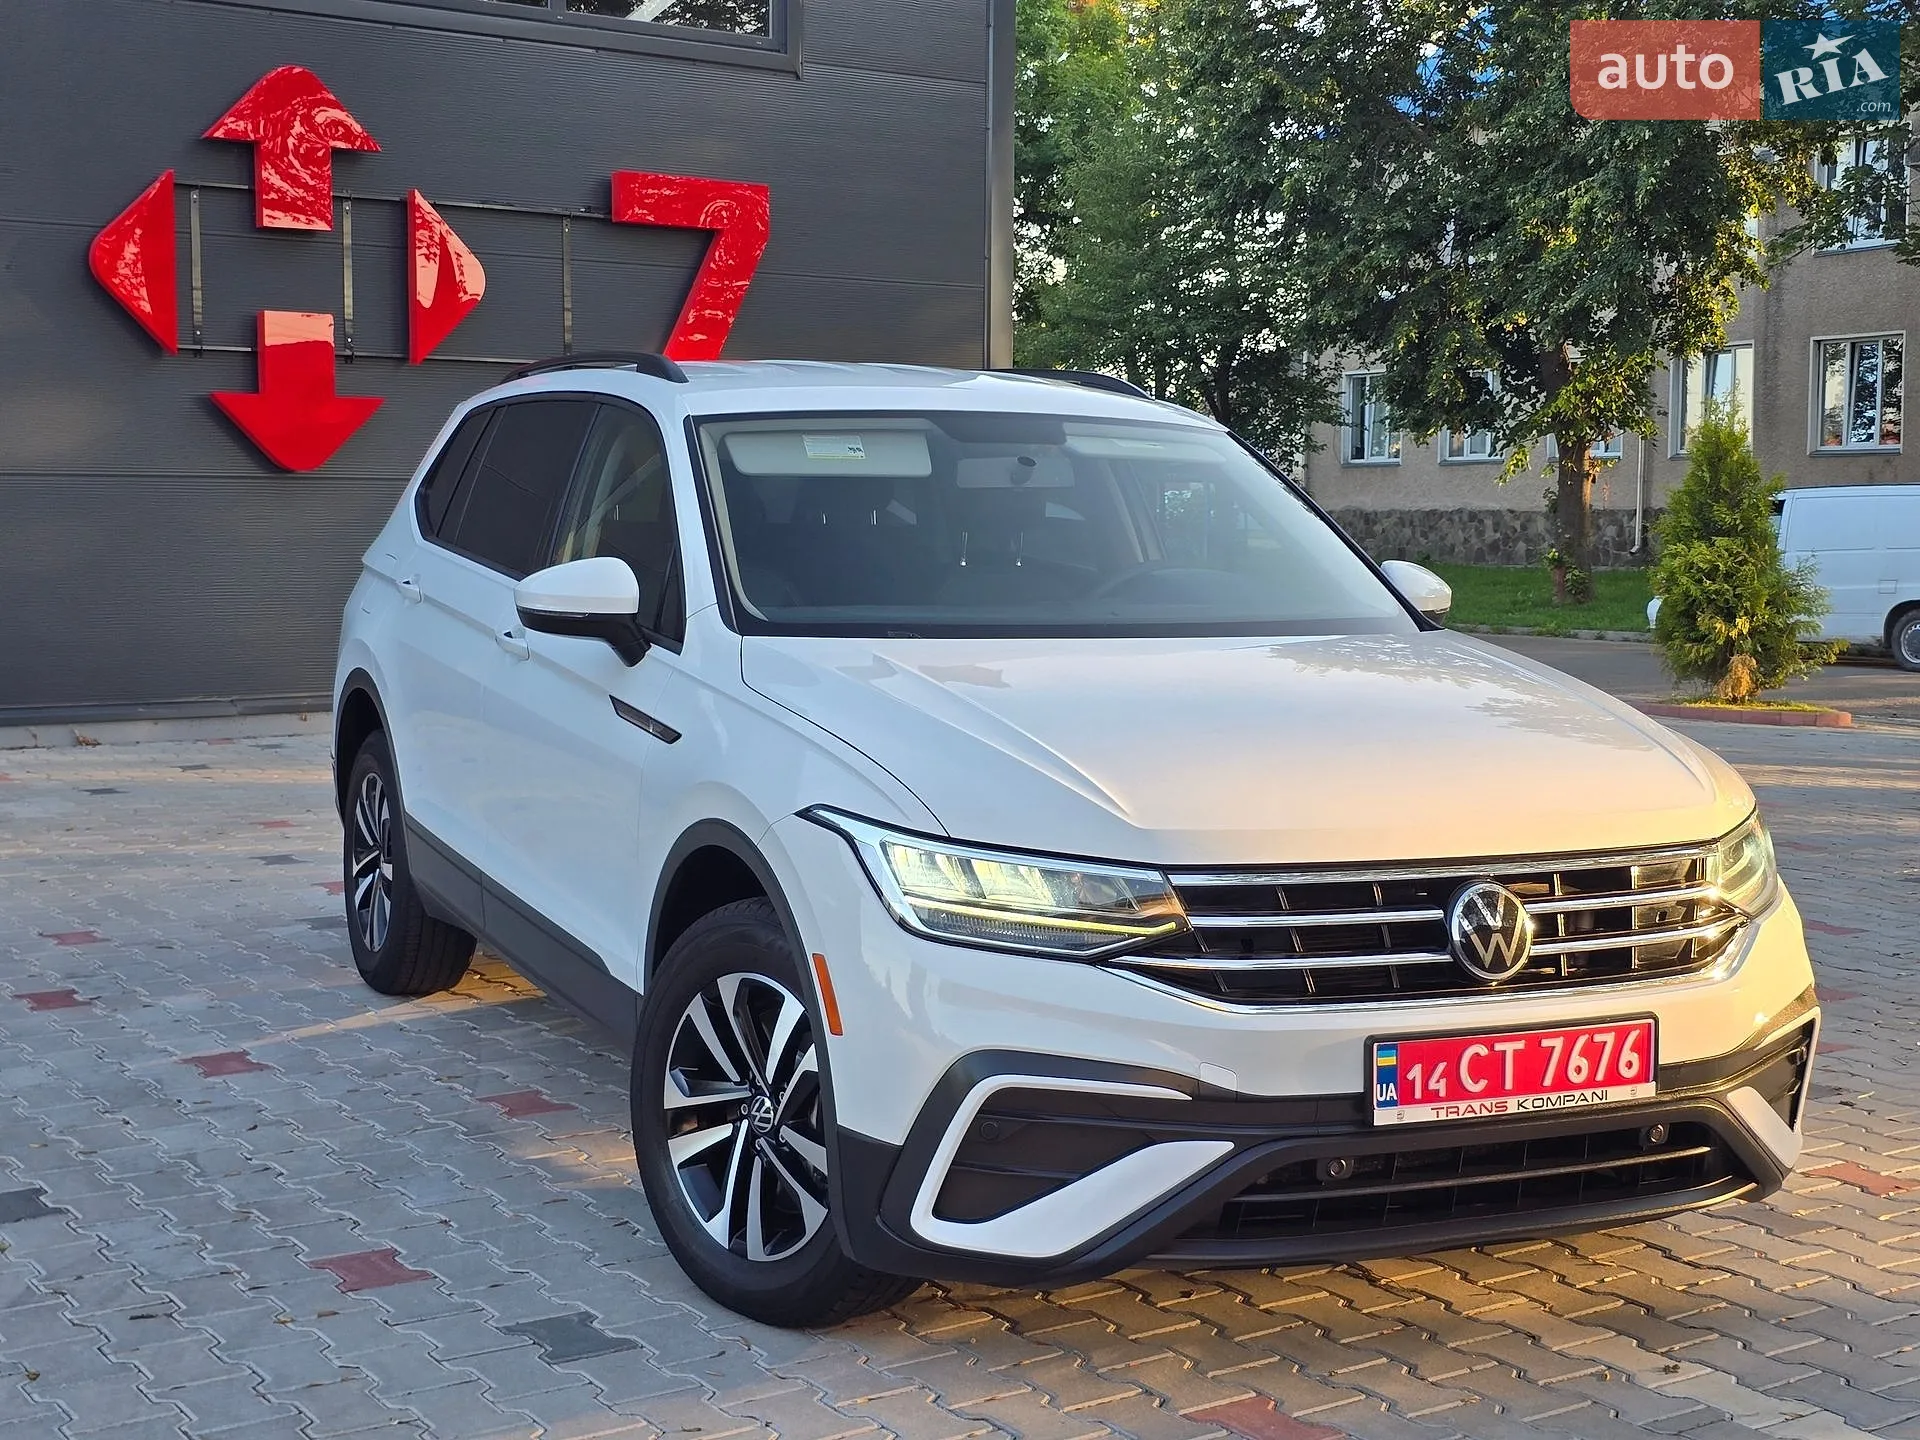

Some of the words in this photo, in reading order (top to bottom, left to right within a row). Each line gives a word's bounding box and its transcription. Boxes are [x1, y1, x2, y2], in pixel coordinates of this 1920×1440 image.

[611, 170, 769, 361] 7
[1406, 1061, 1448, 1100] 14
[1459, 1040, 1525, 1093] CT
[1540, 1028, 1641, 1087] 7676
[1376, 1083, 1398, 1102] UA
[1431, 1101, 1508, 1119] TRANS
[1516, 1089, 1608, 1111] KOMPANI
